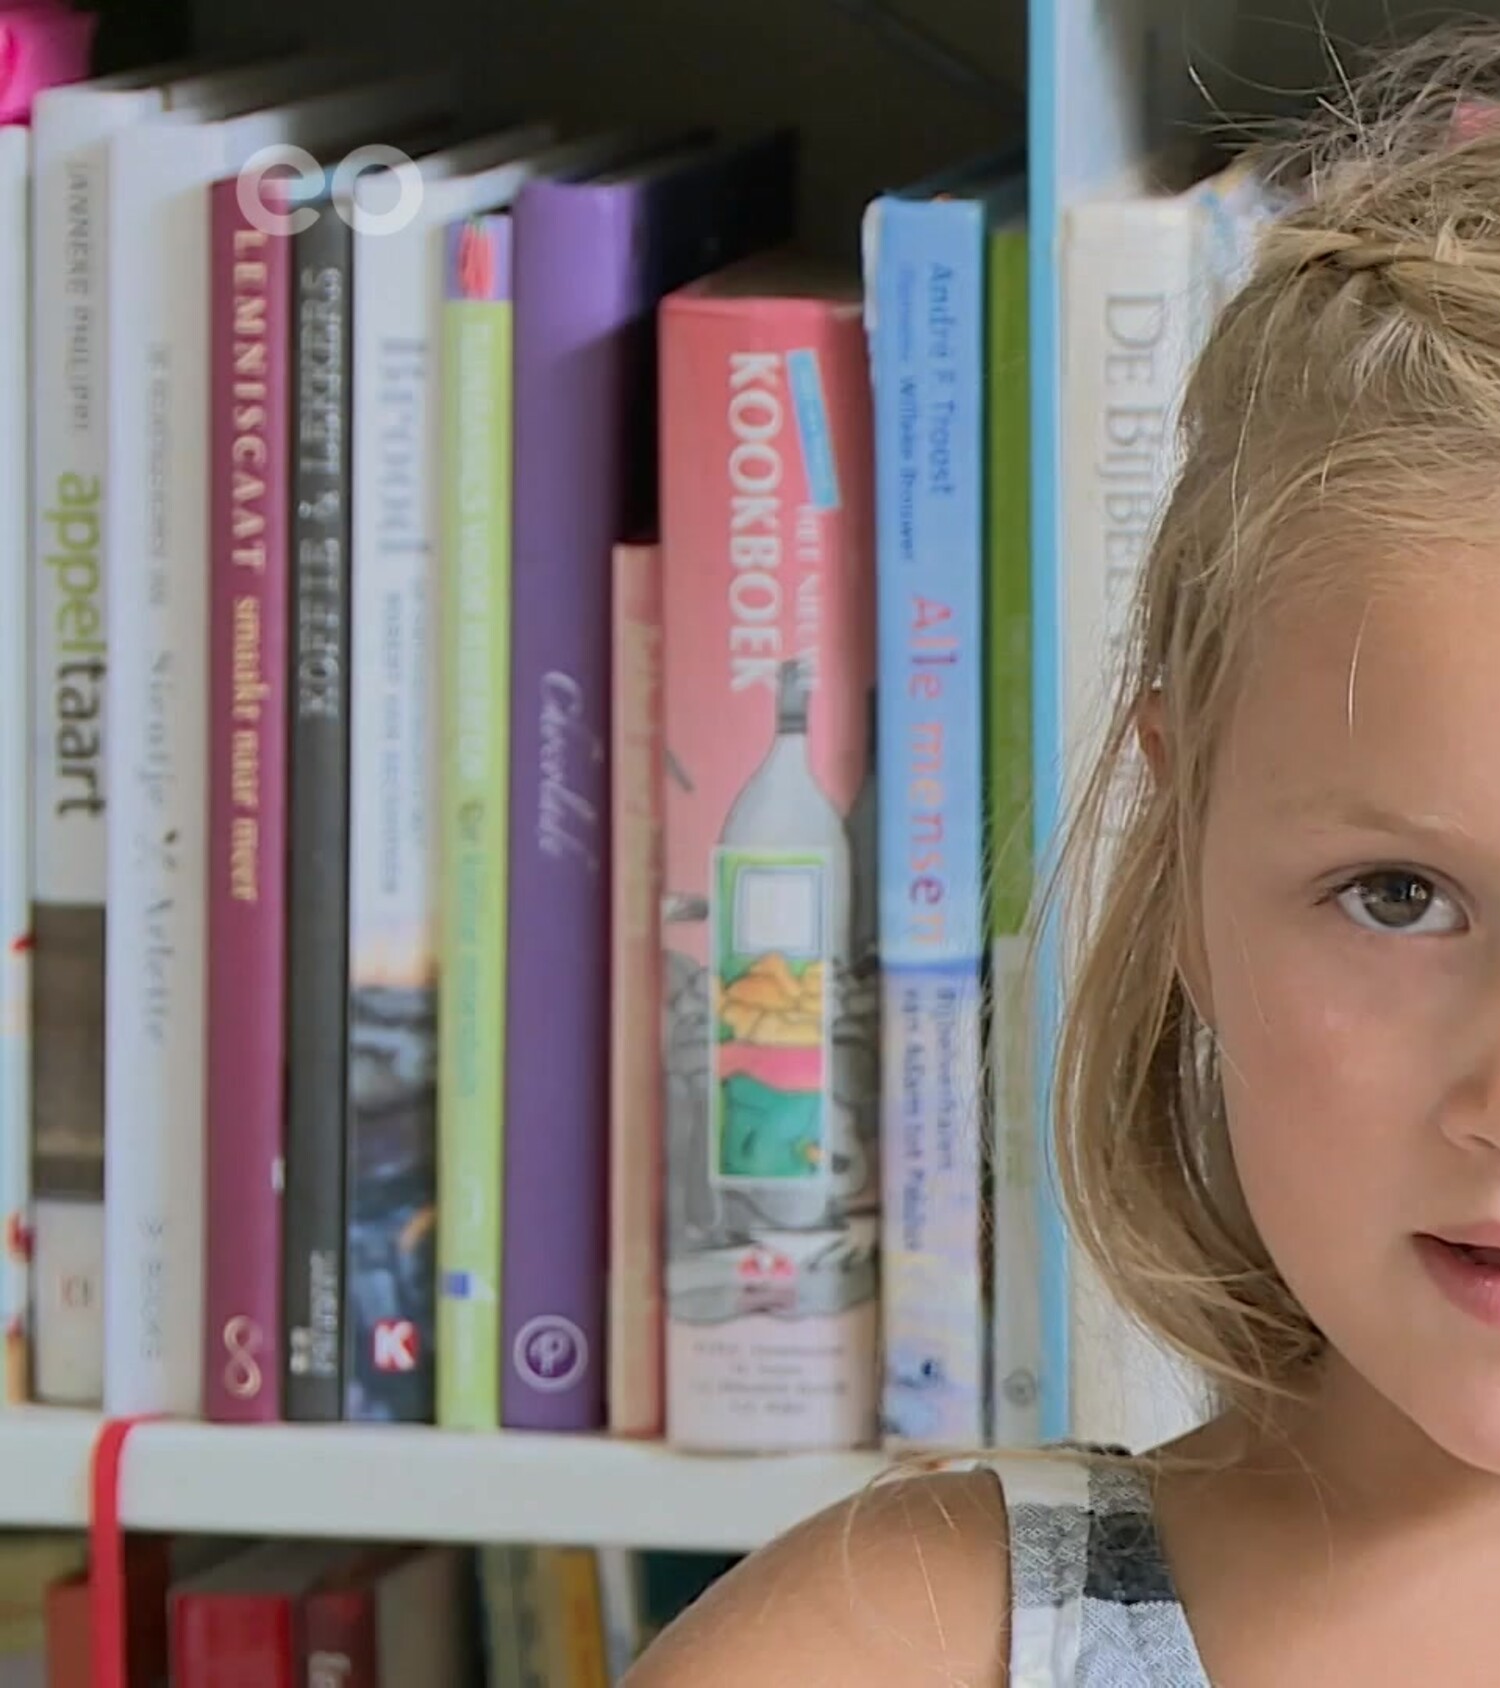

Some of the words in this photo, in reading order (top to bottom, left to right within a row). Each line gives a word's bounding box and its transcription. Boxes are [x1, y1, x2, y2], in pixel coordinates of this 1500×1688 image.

[1103, 292, 1168, 386] DE
[231, 230, 269, 573] LEMNISCAAT
[927, 399, 959, 496] Troost
[729, 352, 784, 693] KOOKBOEK
[44, 473, 107, 817] appeltaart
[231, 595, 272, 720] smaakt
[908, 593, 962, 699] Alle
[231, 730, 262, 806] naar
[229, 817, 261, 903] meer
[908, 720, 948, 944] mensen
[374, 1321, 416, 1370] K
